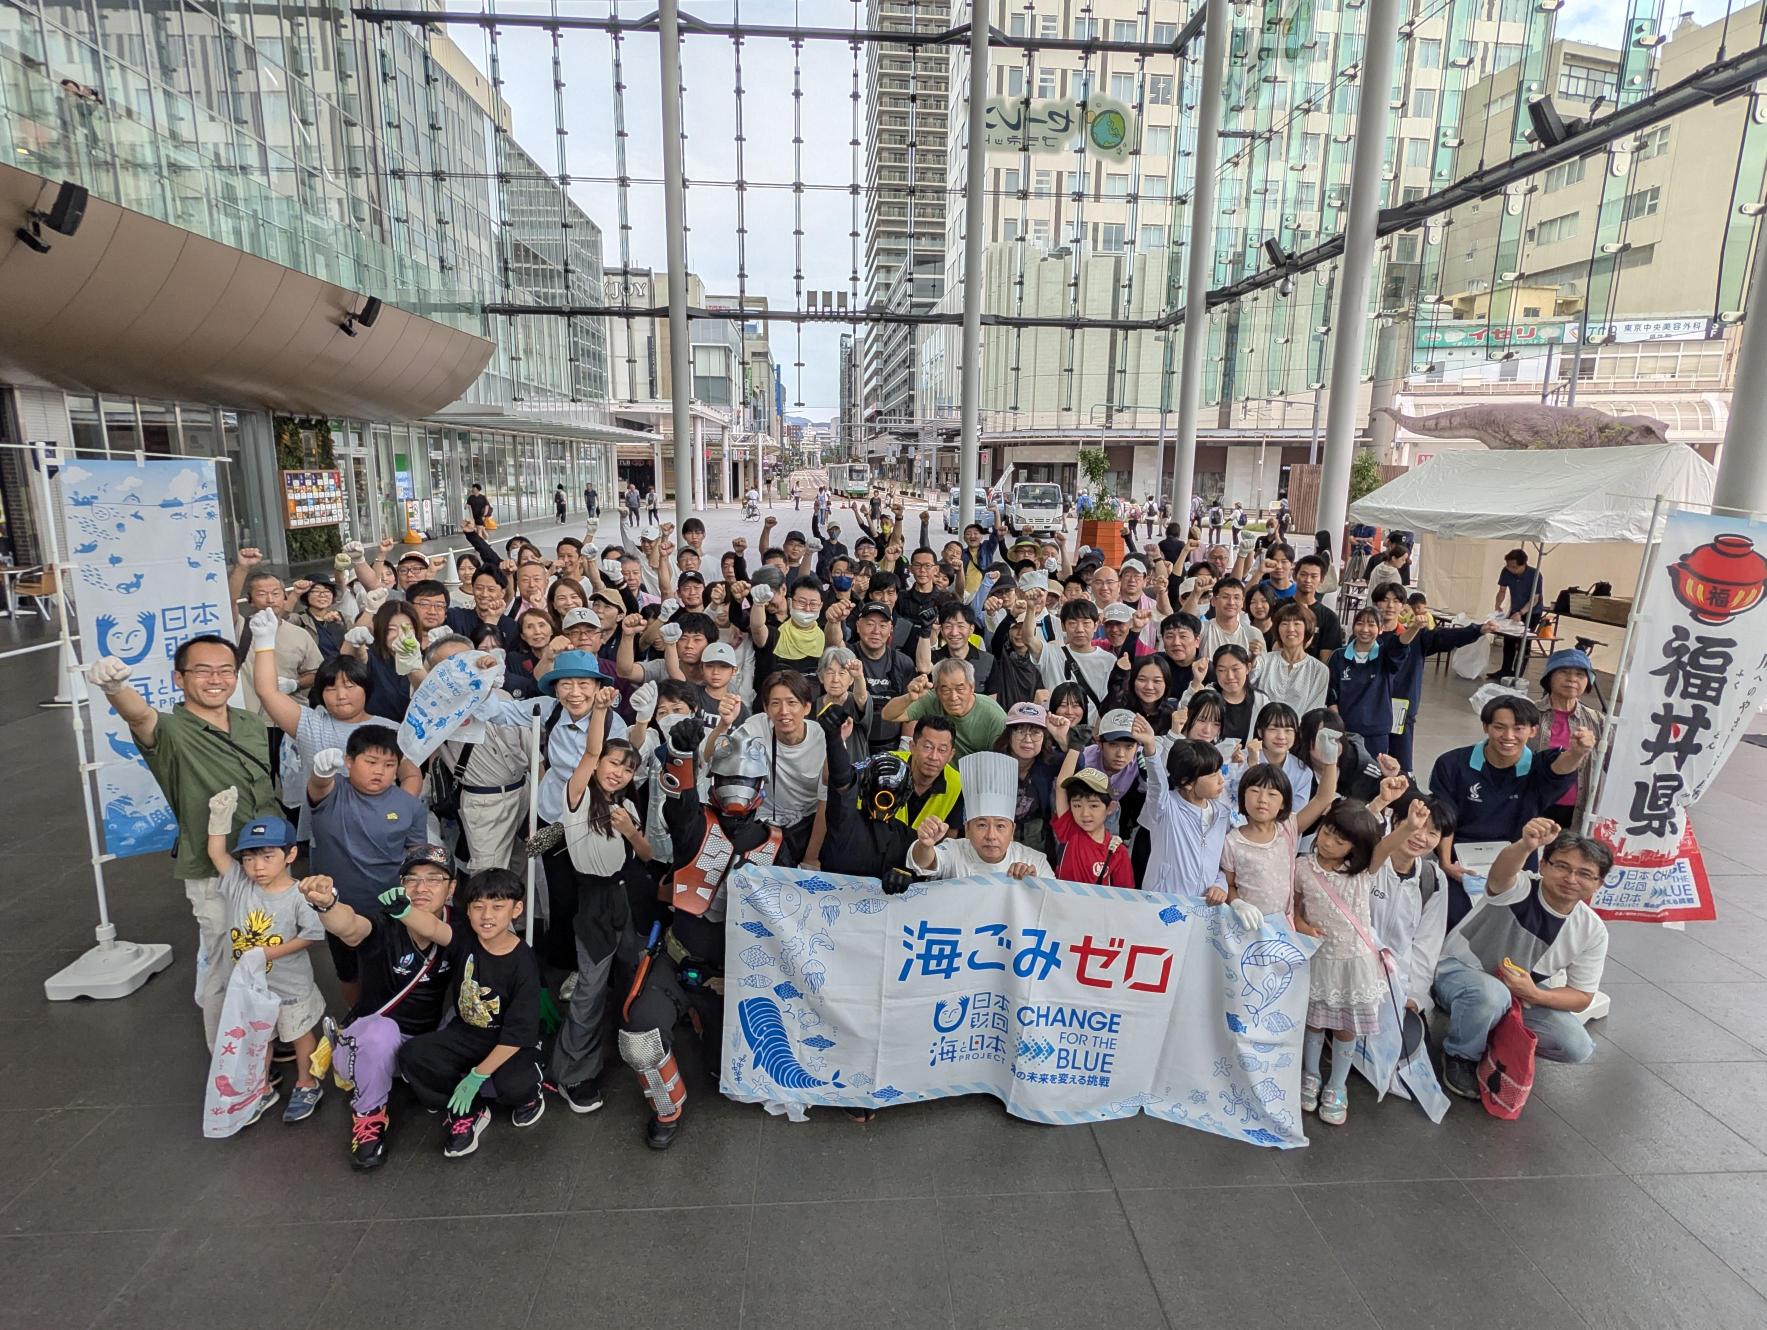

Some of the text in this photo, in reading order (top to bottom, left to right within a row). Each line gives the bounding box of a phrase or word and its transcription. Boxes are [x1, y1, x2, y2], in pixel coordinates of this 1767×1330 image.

[1624, 322, 1702, 333] 東京中央美容外科
[161, 602, 220, 632] 日本
[1664, 883, 1694, 897] LUE
[898, 920, 1174, 993] 海ごみゼロ
[972, 992, 1010, 1013] 日本
[970, 1012, 1008, 1034] 財団
[1016, 1006, 1121, 1033] CHANGE
[929, 1035, 1006, 1067] 海と日本
[1059, 1032, 1117, 1050] FOR THE
[959, 1052, 1006, 1064] PROJECT
[1056, 1047, 1115, 1074] BLUE
